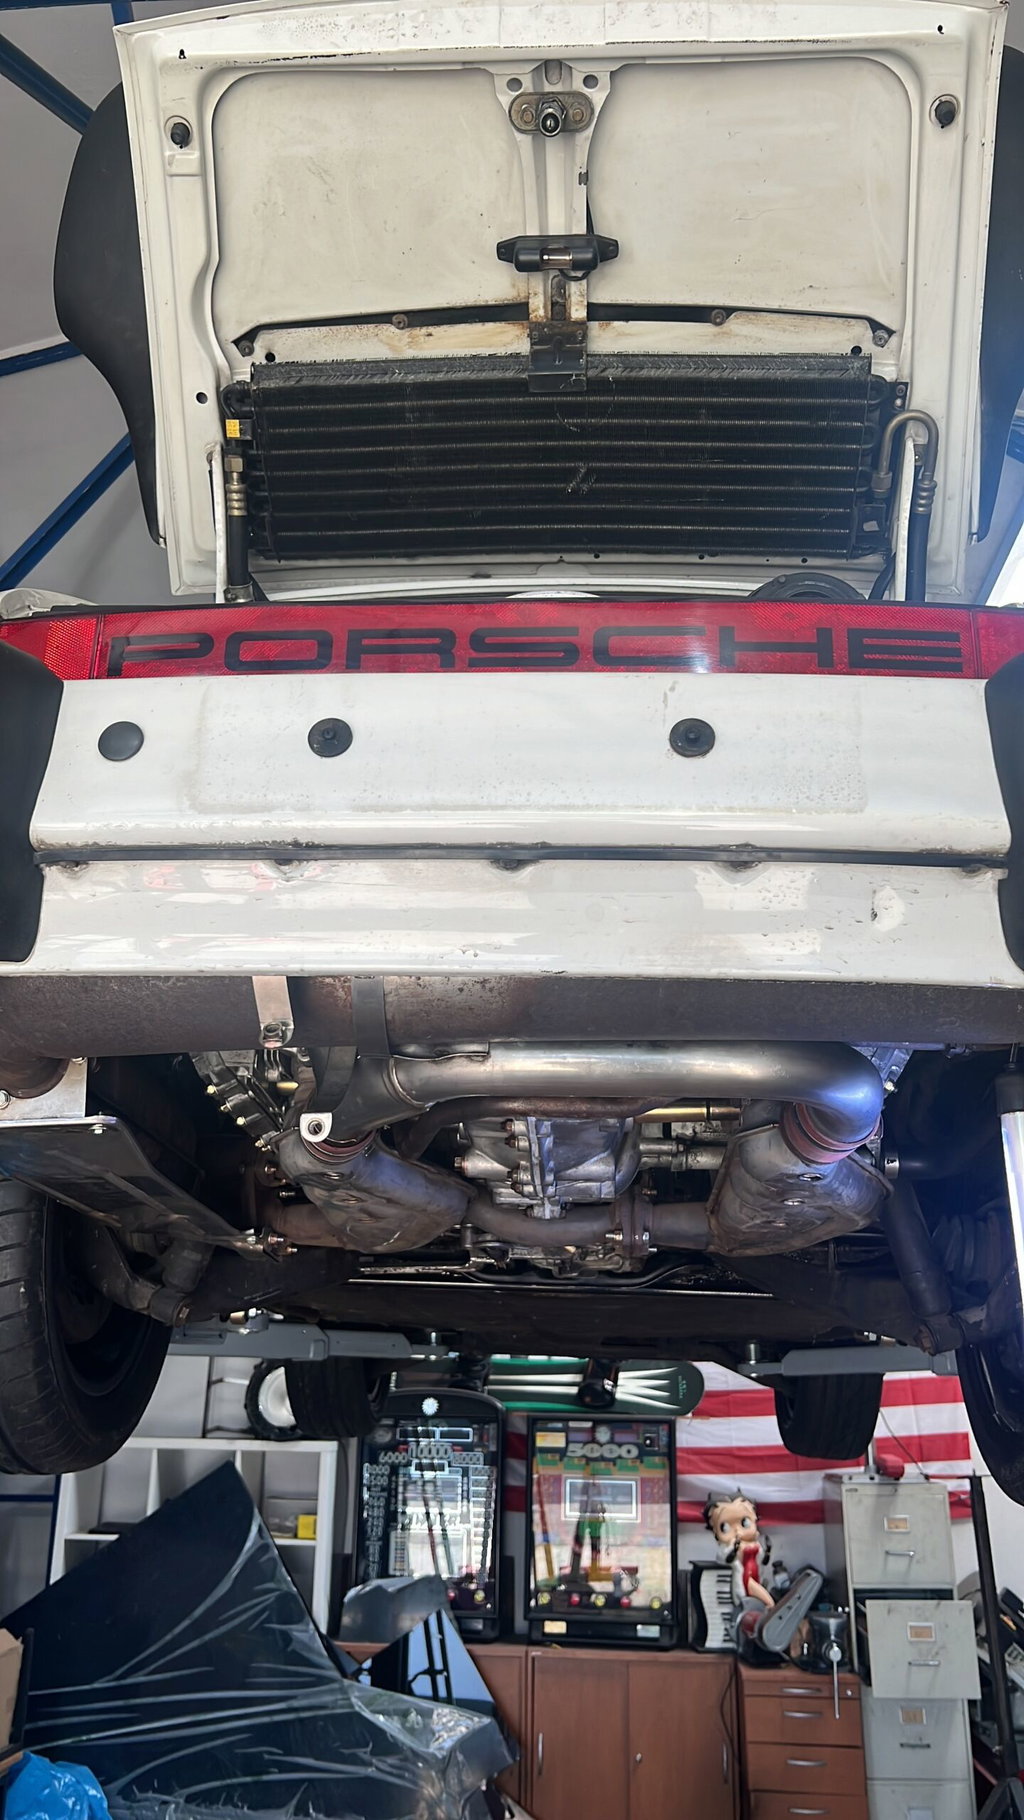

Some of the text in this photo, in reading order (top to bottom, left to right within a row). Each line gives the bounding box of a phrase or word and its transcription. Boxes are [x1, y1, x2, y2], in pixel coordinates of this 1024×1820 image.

[107, 627, 963, 677] PORSCHE
[379, 1451, 408, 1463] 6000
[567, 1443, 639, 1459] 5000
